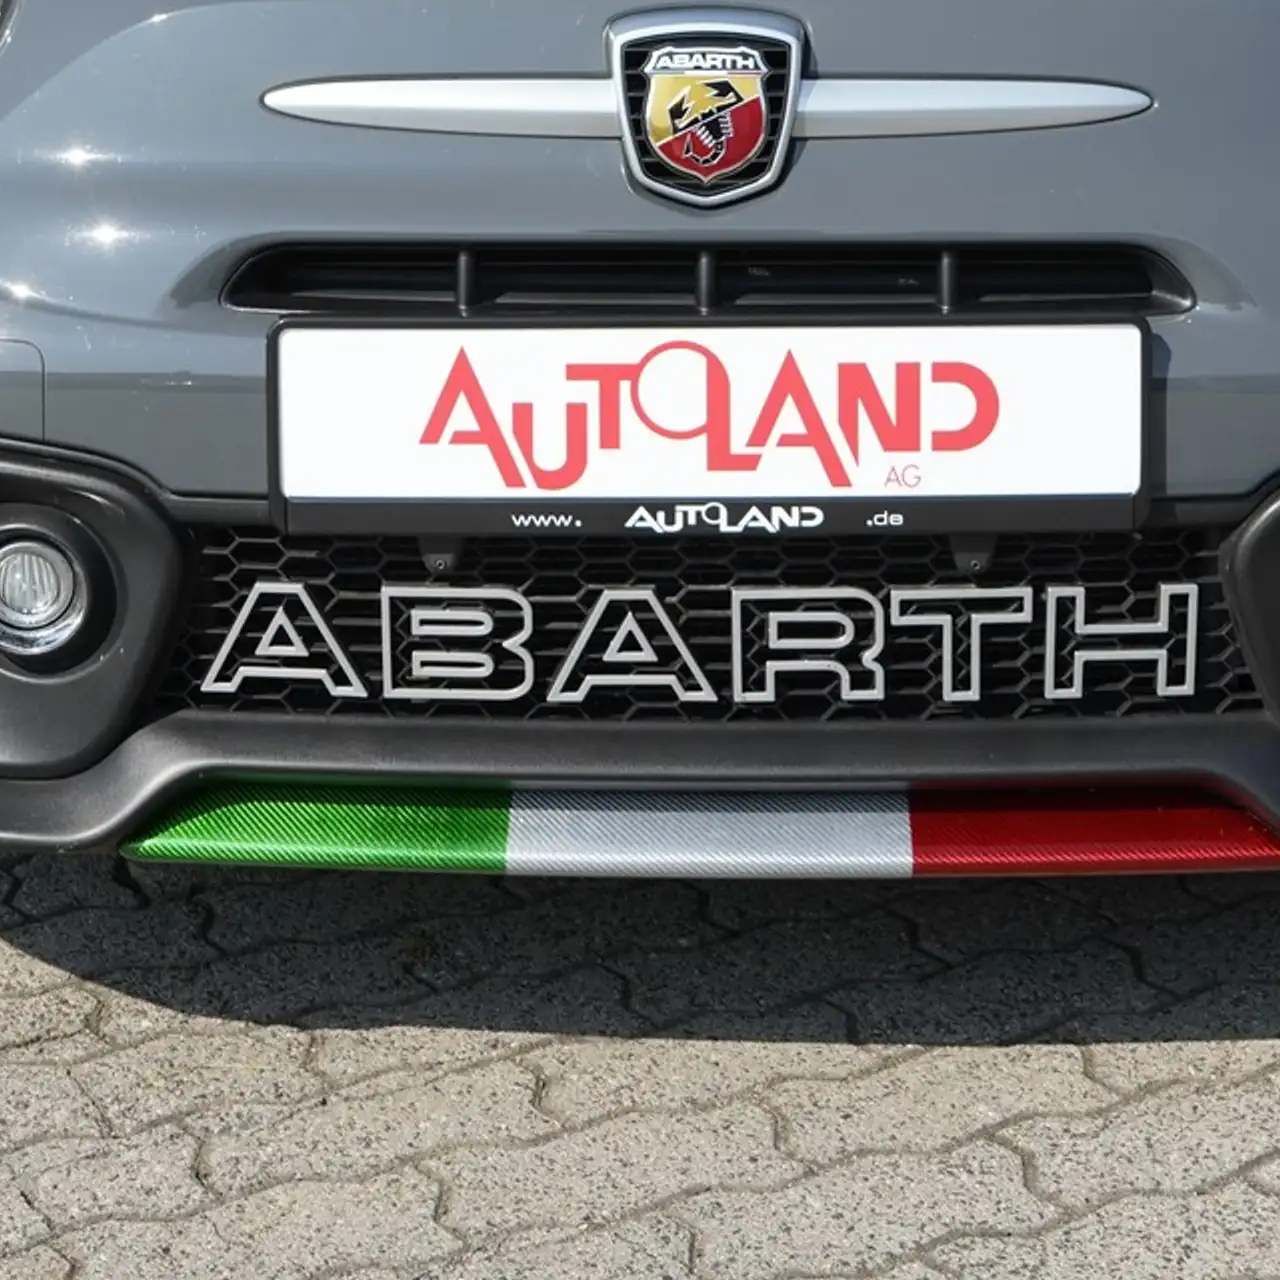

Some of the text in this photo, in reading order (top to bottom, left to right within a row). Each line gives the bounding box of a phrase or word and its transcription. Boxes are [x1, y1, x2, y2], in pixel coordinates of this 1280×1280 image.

[656, 53, 755, 70] ABARTH
[418, 339, 1000, 490] AUTOLAND
[883, 464, 922, 489] AG
[624, 501, 824, 533] AUTOLAND
[199, 579, 1200, 704] ABARTH
